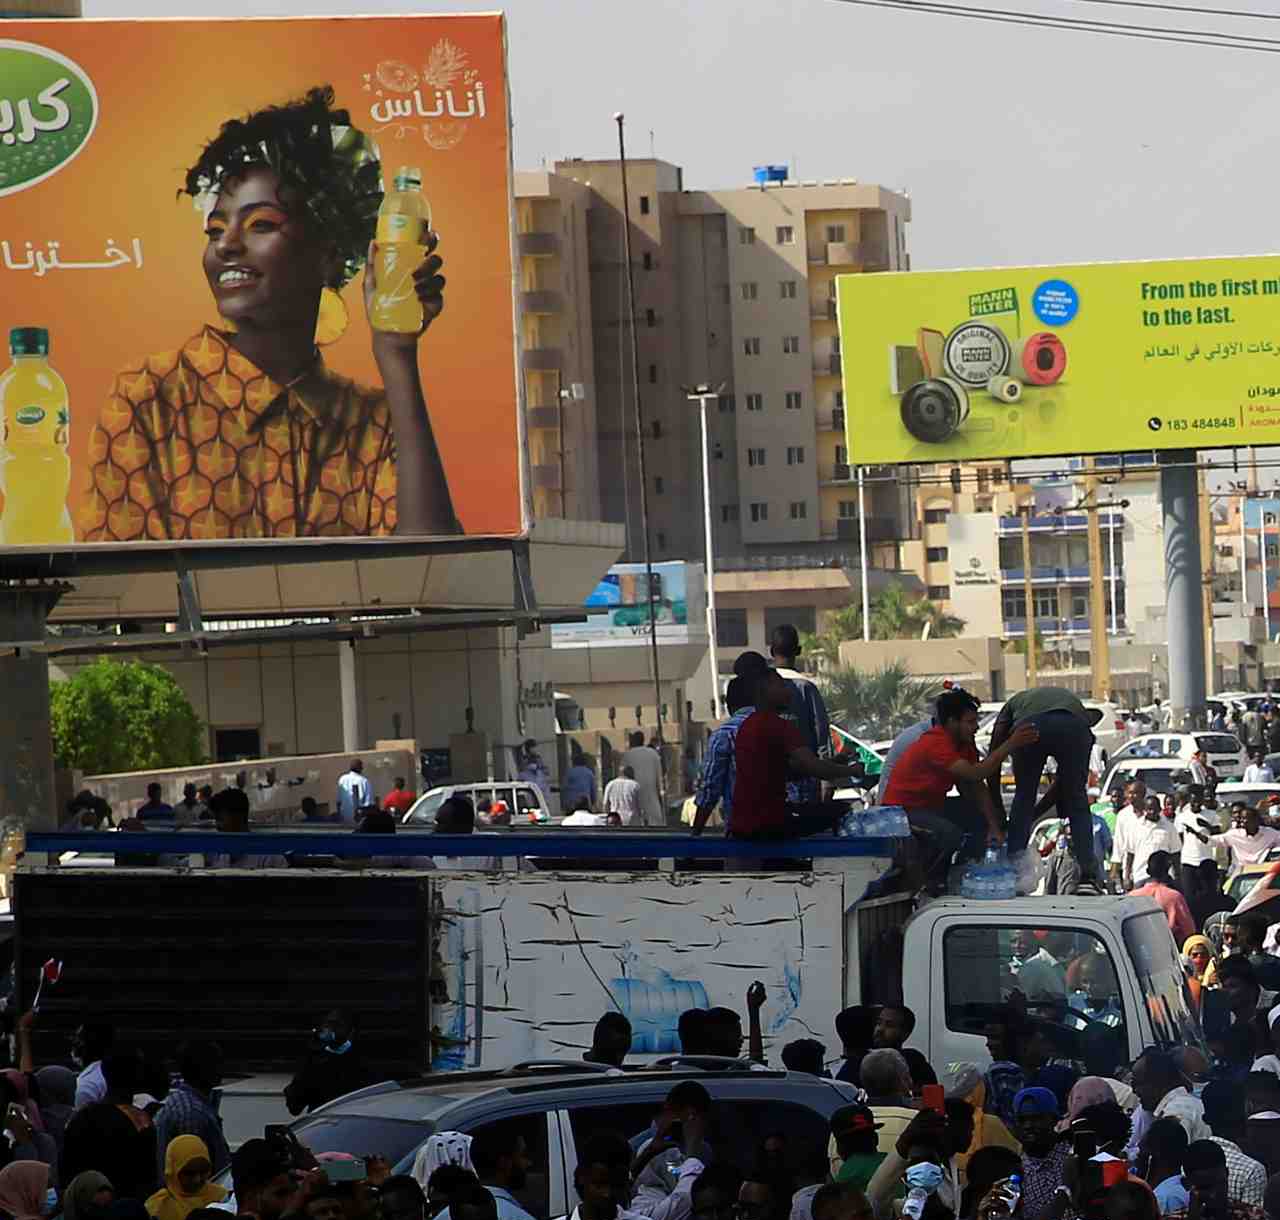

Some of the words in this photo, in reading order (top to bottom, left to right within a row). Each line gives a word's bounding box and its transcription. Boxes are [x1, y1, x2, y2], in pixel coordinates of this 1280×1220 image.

[371, 82, 486, 122] أناناس
[971, 289, 1013, 305] MANN
[1142, 281, 1185, 300] From
[1190, 279, 1217, 297] the
[1223, 278, 1258, 296] first
[971, 299, 1014, 315] FILTER
[1143, 310, 1160, 326] to
[1164, 308, 1192, 325] the
[1197, 306, 1234, 324] last.
[1167, 419, 1188, 431] 183
[1192, 418, 1235, 430] 484848
